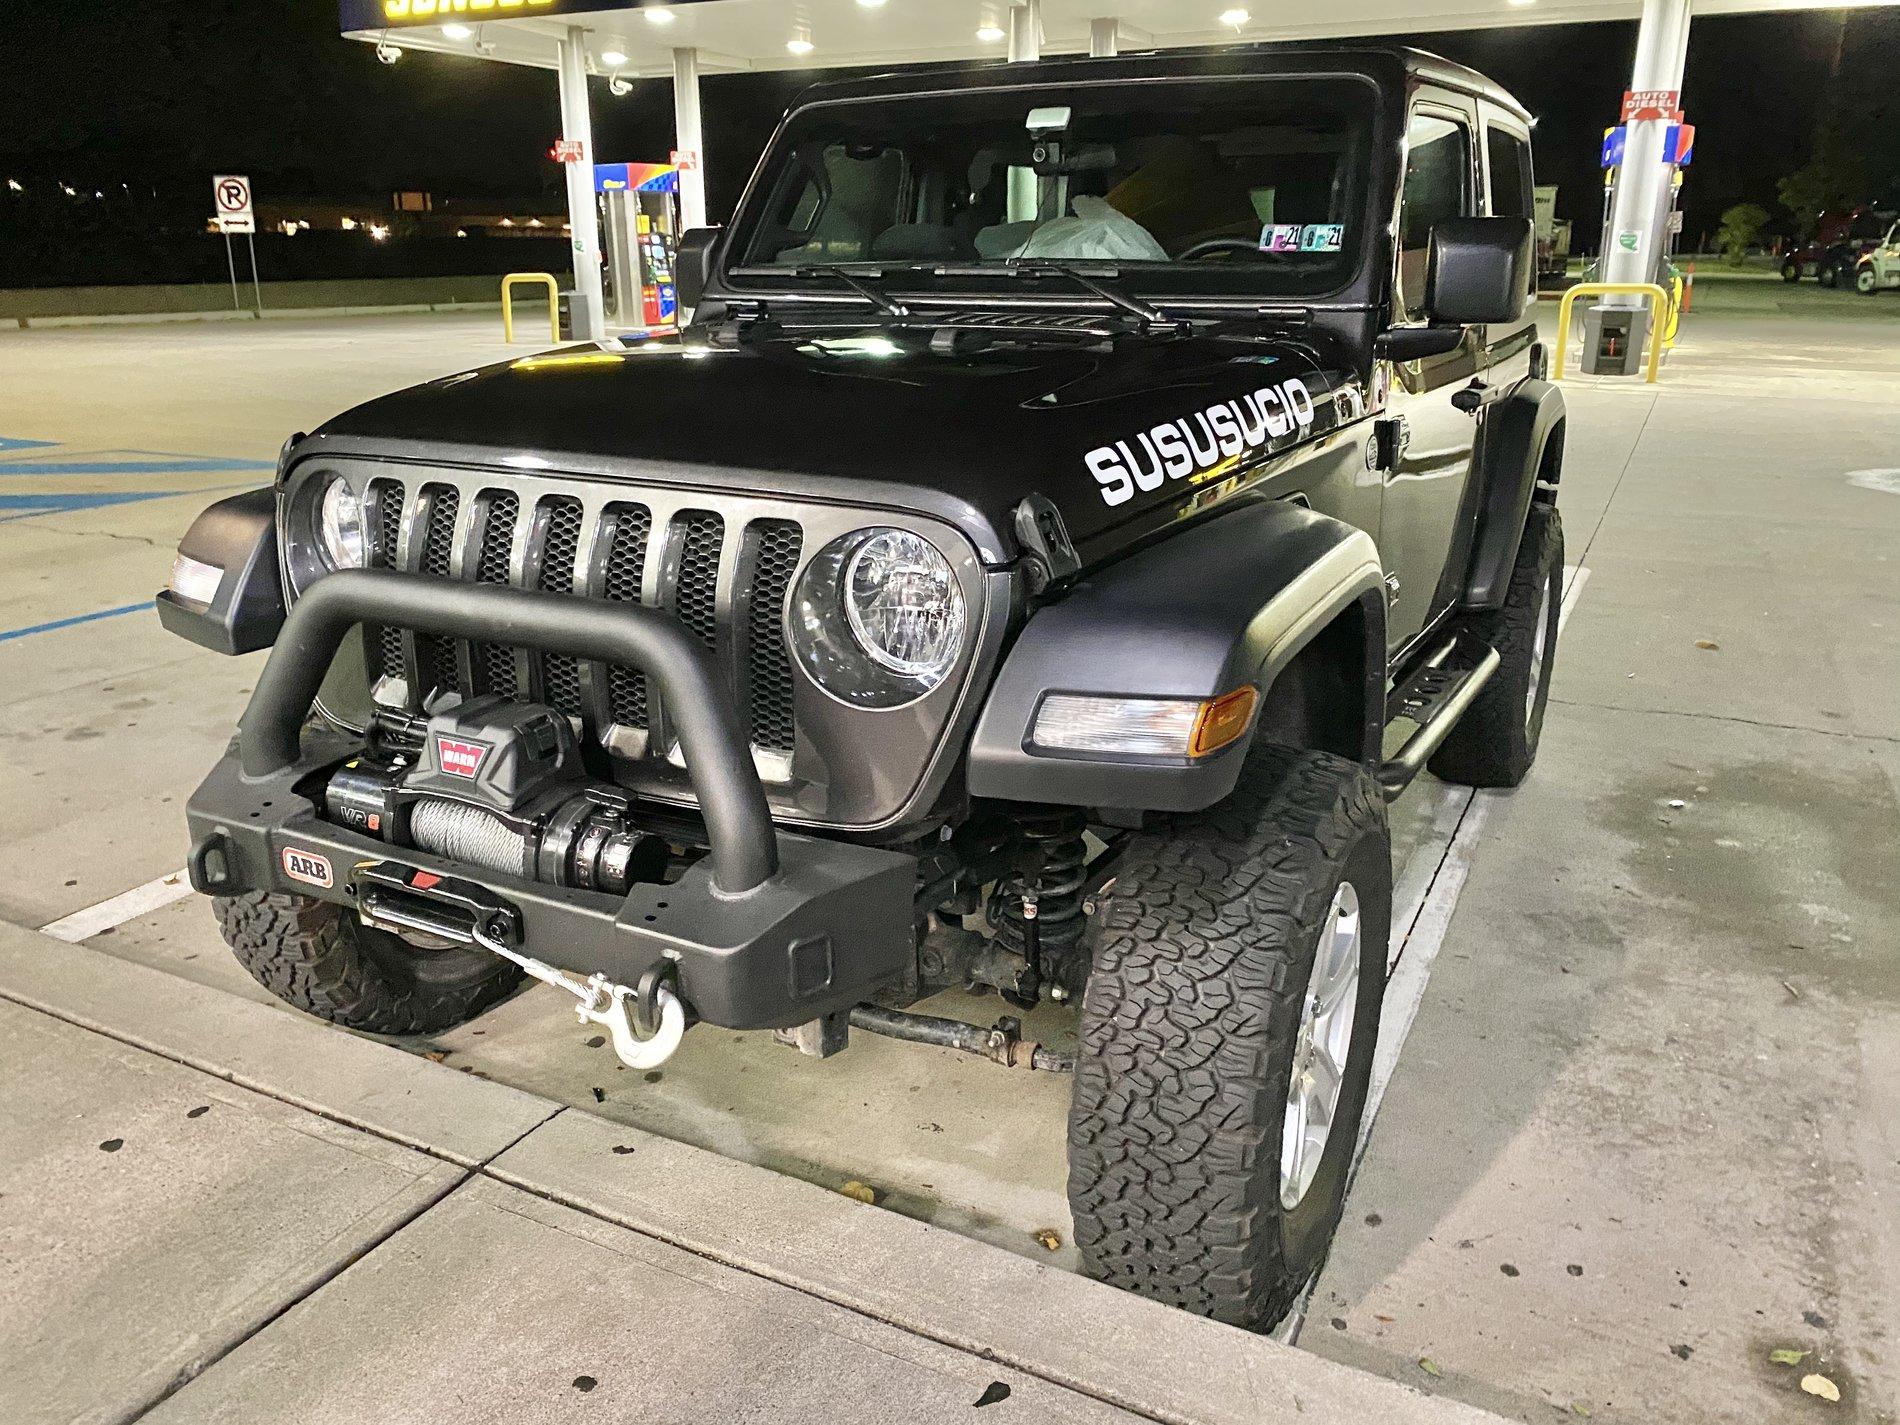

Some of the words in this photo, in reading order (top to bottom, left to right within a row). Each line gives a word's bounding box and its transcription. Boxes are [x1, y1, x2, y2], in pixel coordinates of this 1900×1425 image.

[1626, 99, 1675, 109] DIESEL
[1632, 91, 1669, 100] AUTO
[1264, 230, 1273, 247] 6
[1286, 226, 1300, 245] 21
[1084, 378, 1315, 507] SUSUSUCIO
[443, 749, 476, 768] WARN
[290, 855, 327, 880] ARB
